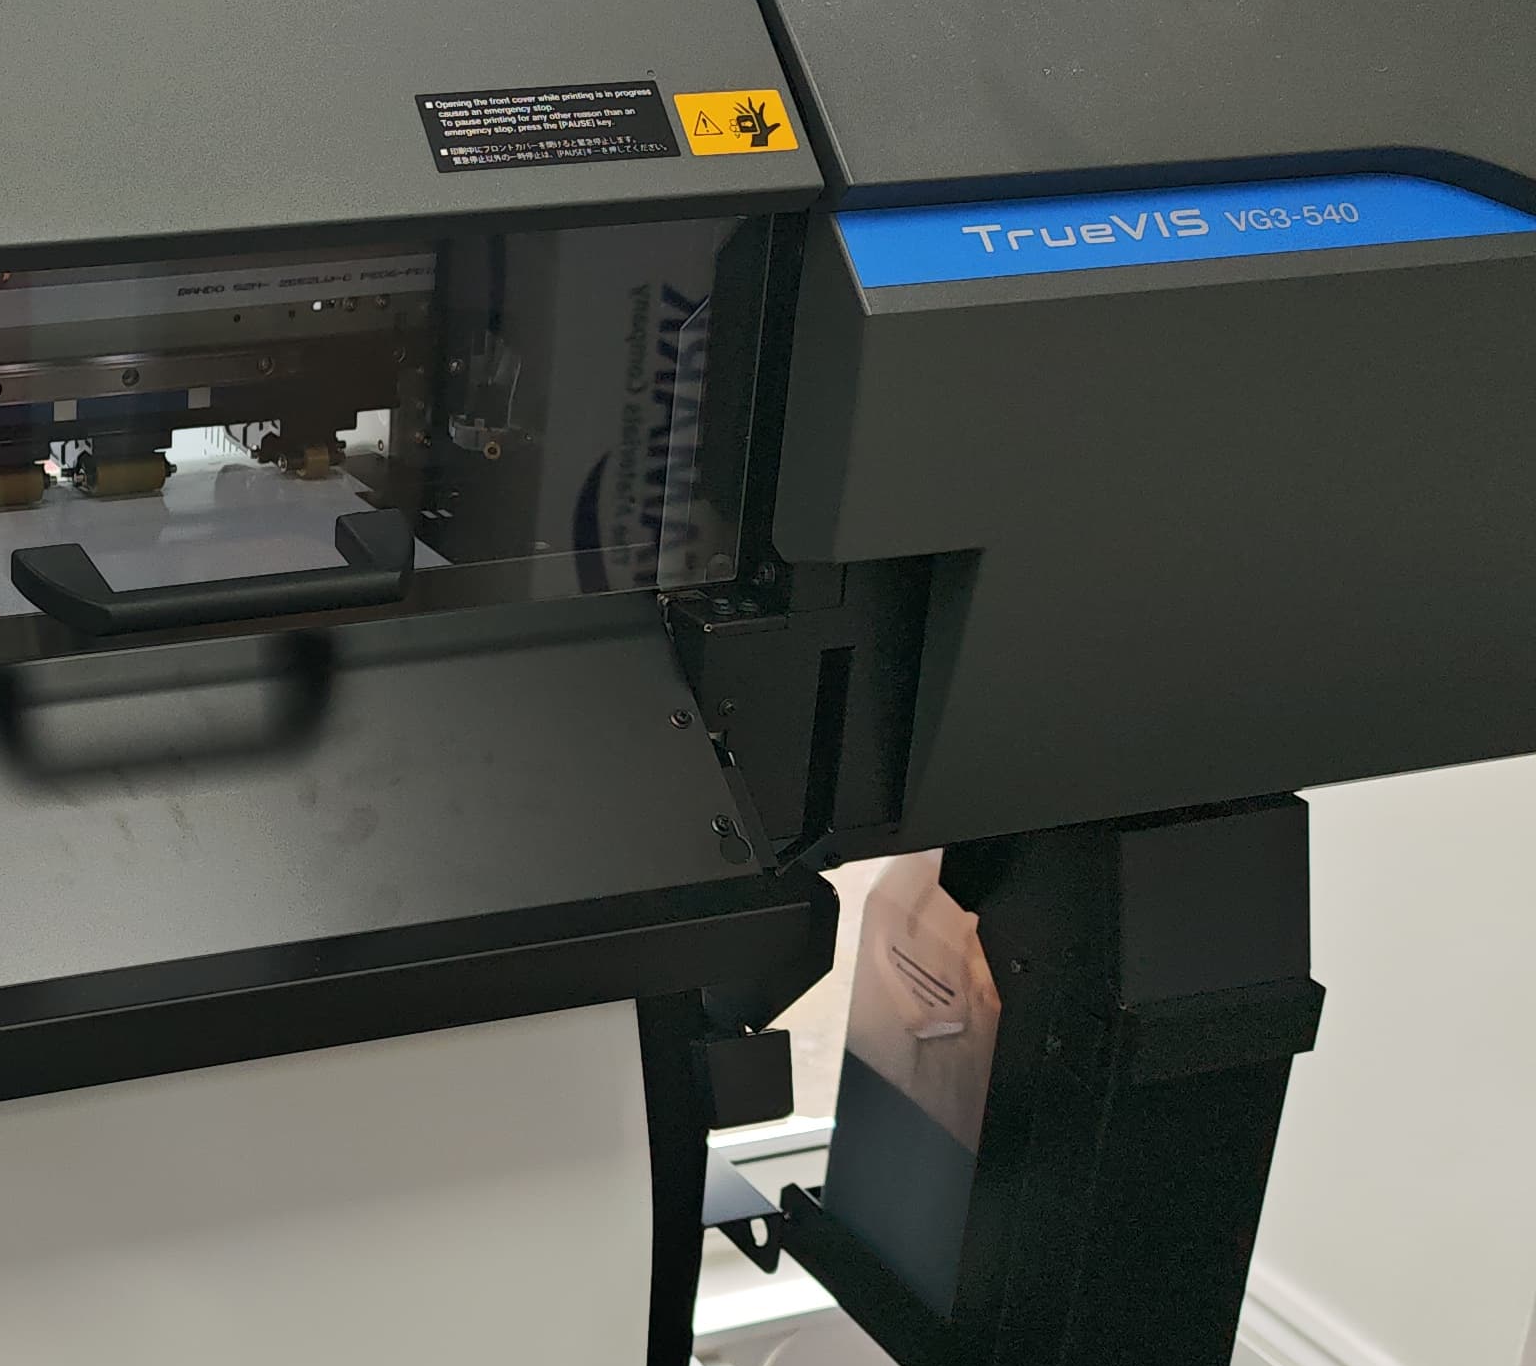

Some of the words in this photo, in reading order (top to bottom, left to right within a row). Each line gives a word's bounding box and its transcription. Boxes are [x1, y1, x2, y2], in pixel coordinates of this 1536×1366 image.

[435, 100, 472, 109] Opening
[473, 98, 487, 106] the
[489, 97, 510, 105] front
[538, 94, 560, 102] while
[562, 92, 594, 101] printing
[615, 89, 651, 98] progress
[484, 106, 530, 115] emergency
[440, 119, 453, 127] To
[455, 118, 481, 127] pause
[483, 115, 516, 125] printing
[532, 114, 547, 122] any
[444, 128, 492, 136] emergency
[518, 124, 542, 132] press
[559, 119, 596, 129] [PAUSE]
[962, 208, 1211, 253] TrueVIS
[1225, 202, 1360, 232] VG3-540
